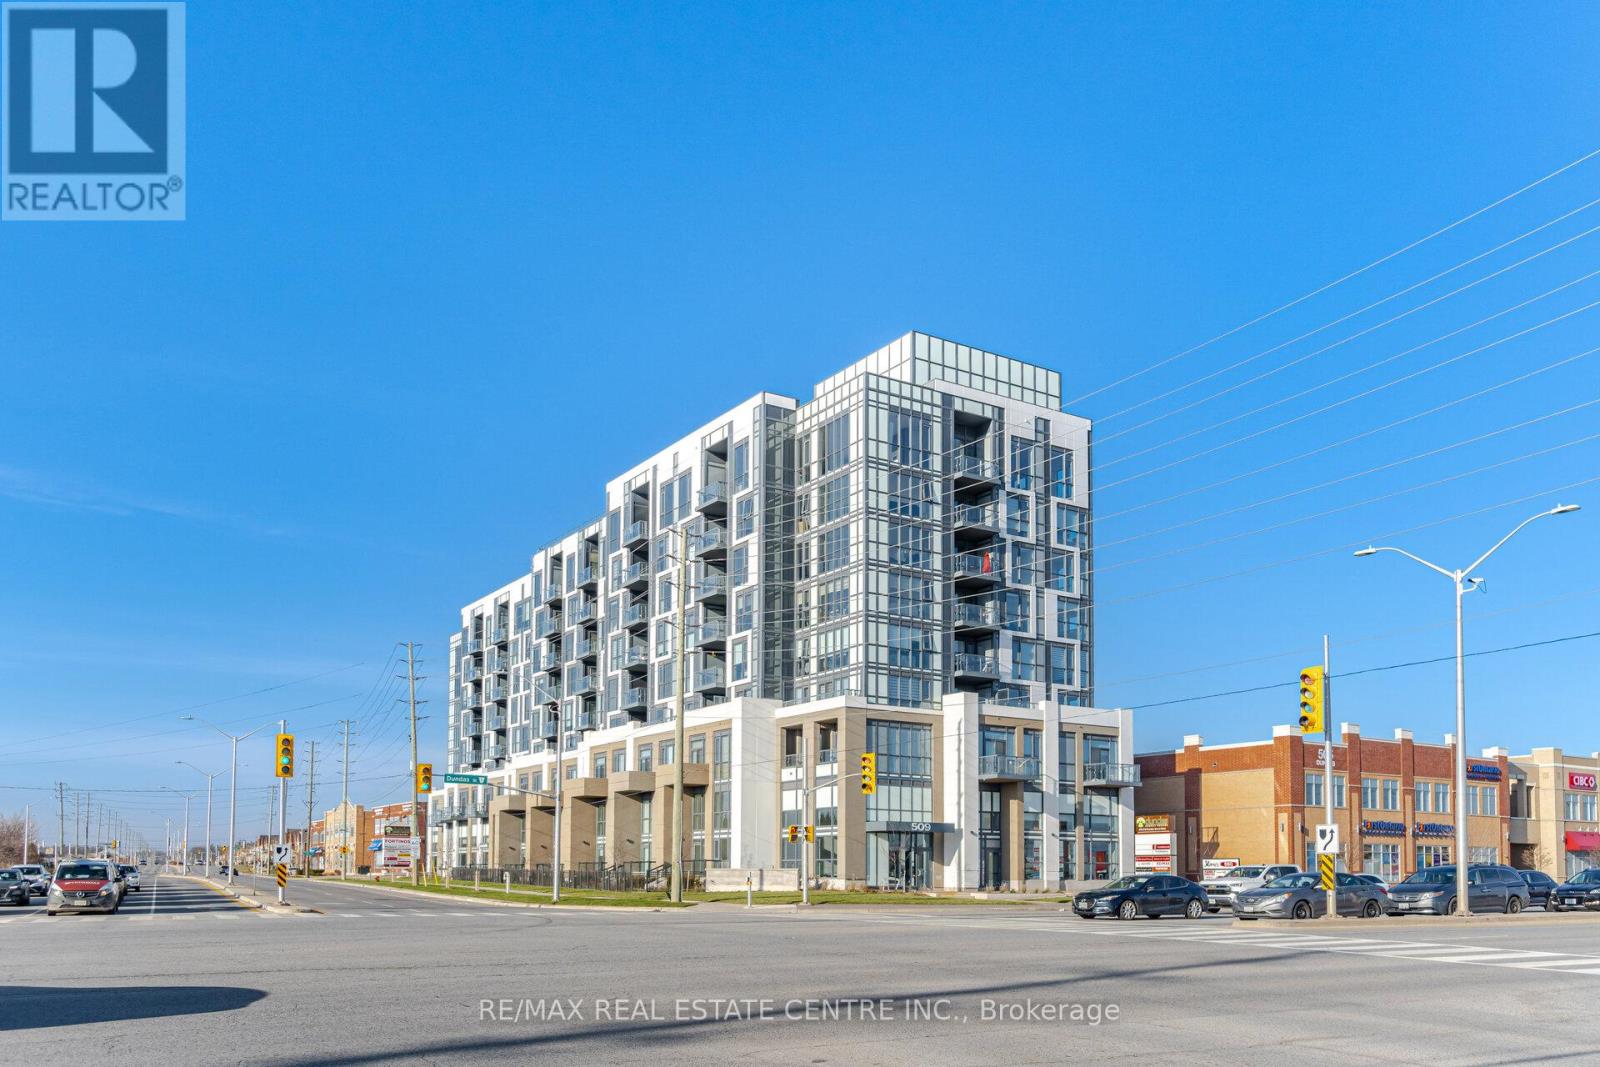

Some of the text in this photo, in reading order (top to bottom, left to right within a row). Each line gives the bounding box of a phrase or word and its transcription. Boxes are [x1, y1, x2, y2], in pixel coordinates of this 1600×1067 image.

[446, 775, 470, 783] Dundas
[1573, 775, 1588, 787] CIBC
[911, 822, 931, 831] 509
